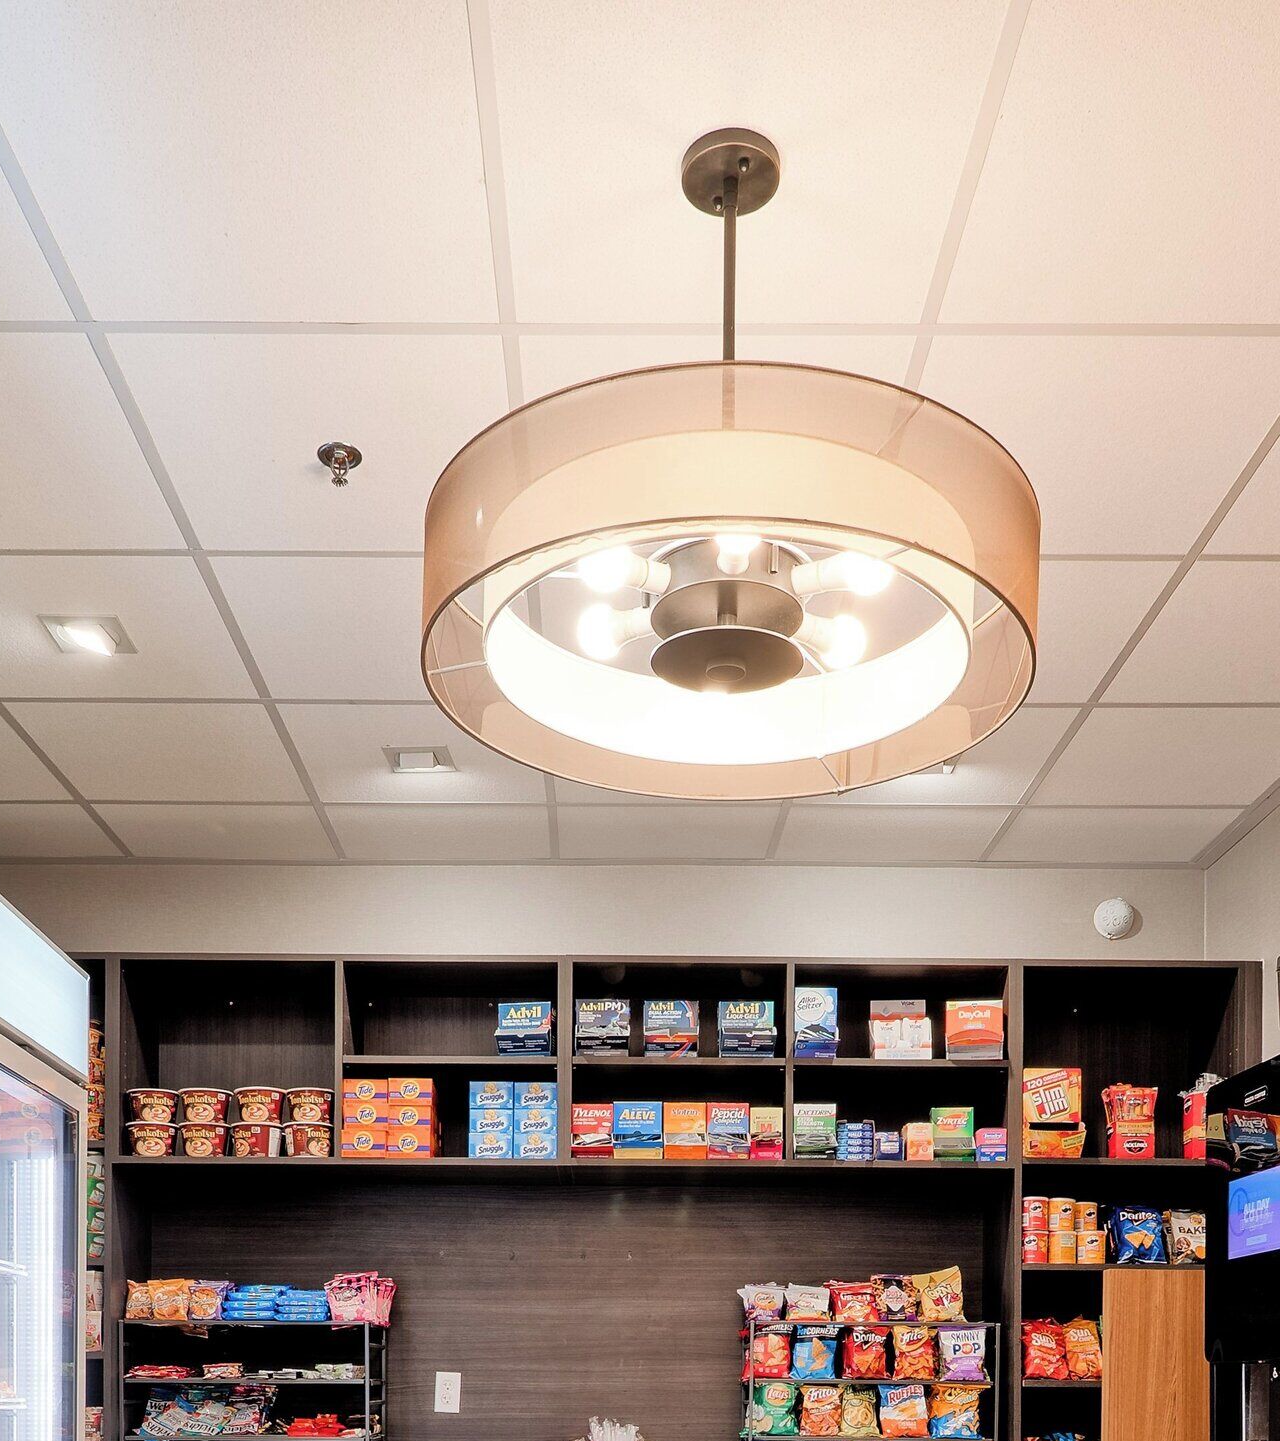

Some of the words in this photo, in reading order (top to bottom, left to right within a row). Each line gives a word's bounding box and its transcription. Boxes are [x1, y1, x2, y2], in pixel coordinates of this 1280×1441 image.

[580, 1002, 604, 1011] Advil
[605, 1002, 621, 1011] PM
[648, 1002, 674, 1011] Advil
[725, 1003, 760, 1014] Advil
[797, 1002, 822, 1011] Seltzer
[506, 1006, 541, 1019] Advil
[958, 1010, 990, 1020] DayQuil
[403, 1084, 418, 1095] Tide
[1025, 1079, 1042, 1090] 120
[358, 1085, 373, 1096] Tide
[480, 1093, 504, 1103] Snuggle
[524, 1093, 549, 1104] Snuggle
[360, 1109, 375, 1120] Tide
[401, 1112, 416, 1122] Tide
[573, 1108, 612, 1117] TYLENOL
[619, 1109, 656, 1120] ALEVE
[711, 1107, 745, 1119] Pepcid
[480, 1120, 504, 1130] Snuggle
[523, 1119, 548, 1130] Snuggle
[936, 1117, 968, 1125] ZYRTEC
[356, 1136, 371, 1147] Tide
[401, 1138, 416, 1149] Tide
[478, 1144, 504, 1154] Snuggle
[523, 1144, 548, 1155] Snuggle
[1178, 1226, 1207, 1234] BAKE
[888, 1385, 924, 1404] RUFFLES
